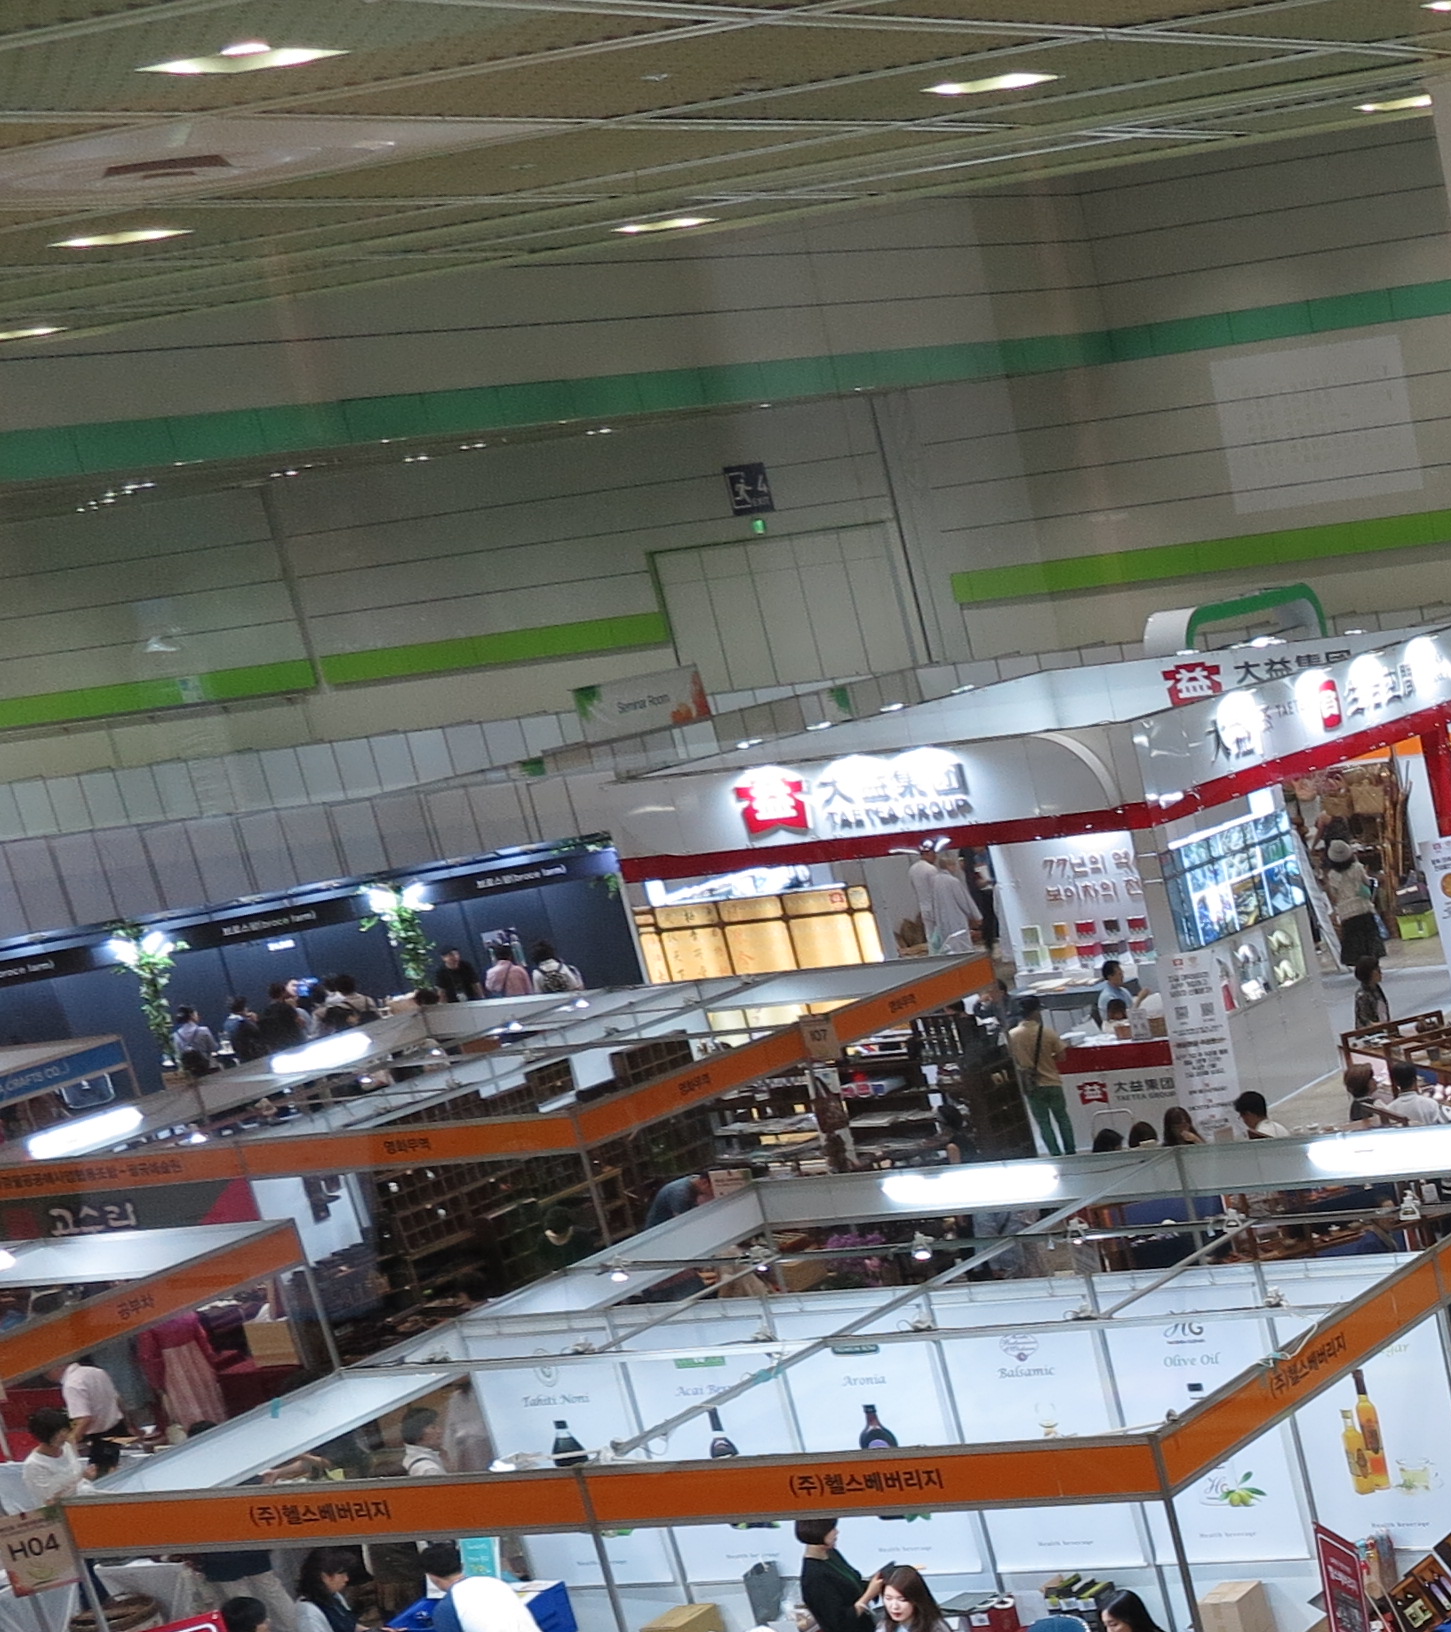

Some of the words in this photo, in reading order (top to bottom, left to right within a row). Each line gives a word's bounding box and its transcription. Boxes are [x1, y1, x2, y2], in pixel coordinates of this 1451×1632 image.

[757, 473, 769, 495] 4
[617, 698, 647, 714] Seminar
[648, 692, 672, 707] Room
[903, 797, 976, 823] GROUP
[1113, 1076, 1176, 1094] 大益集团
[118, 1293, 155, 1321] 공부차
[1163, 1352, 1197, 1369] Olive
[1199, 1351, 1220, 1367] Oil
[1270, 1331, 1347, 1401] (주)헬스베버리지
[841, 1370, 887, 1388] Aronia
[996, 1363, 1056, 1380] Balsamic
[521, 1393, 557, 1410] Tahiti
[558, 1391, 591, 1407] Noni
[675, 1384, 703, 1399] Acai
[788, 1468, 944, 1498] (주)헬스베버리지
[249, 1499, 393, 1528] (주)헬스베버리지
[7, 1532, 61, 1562] H04
